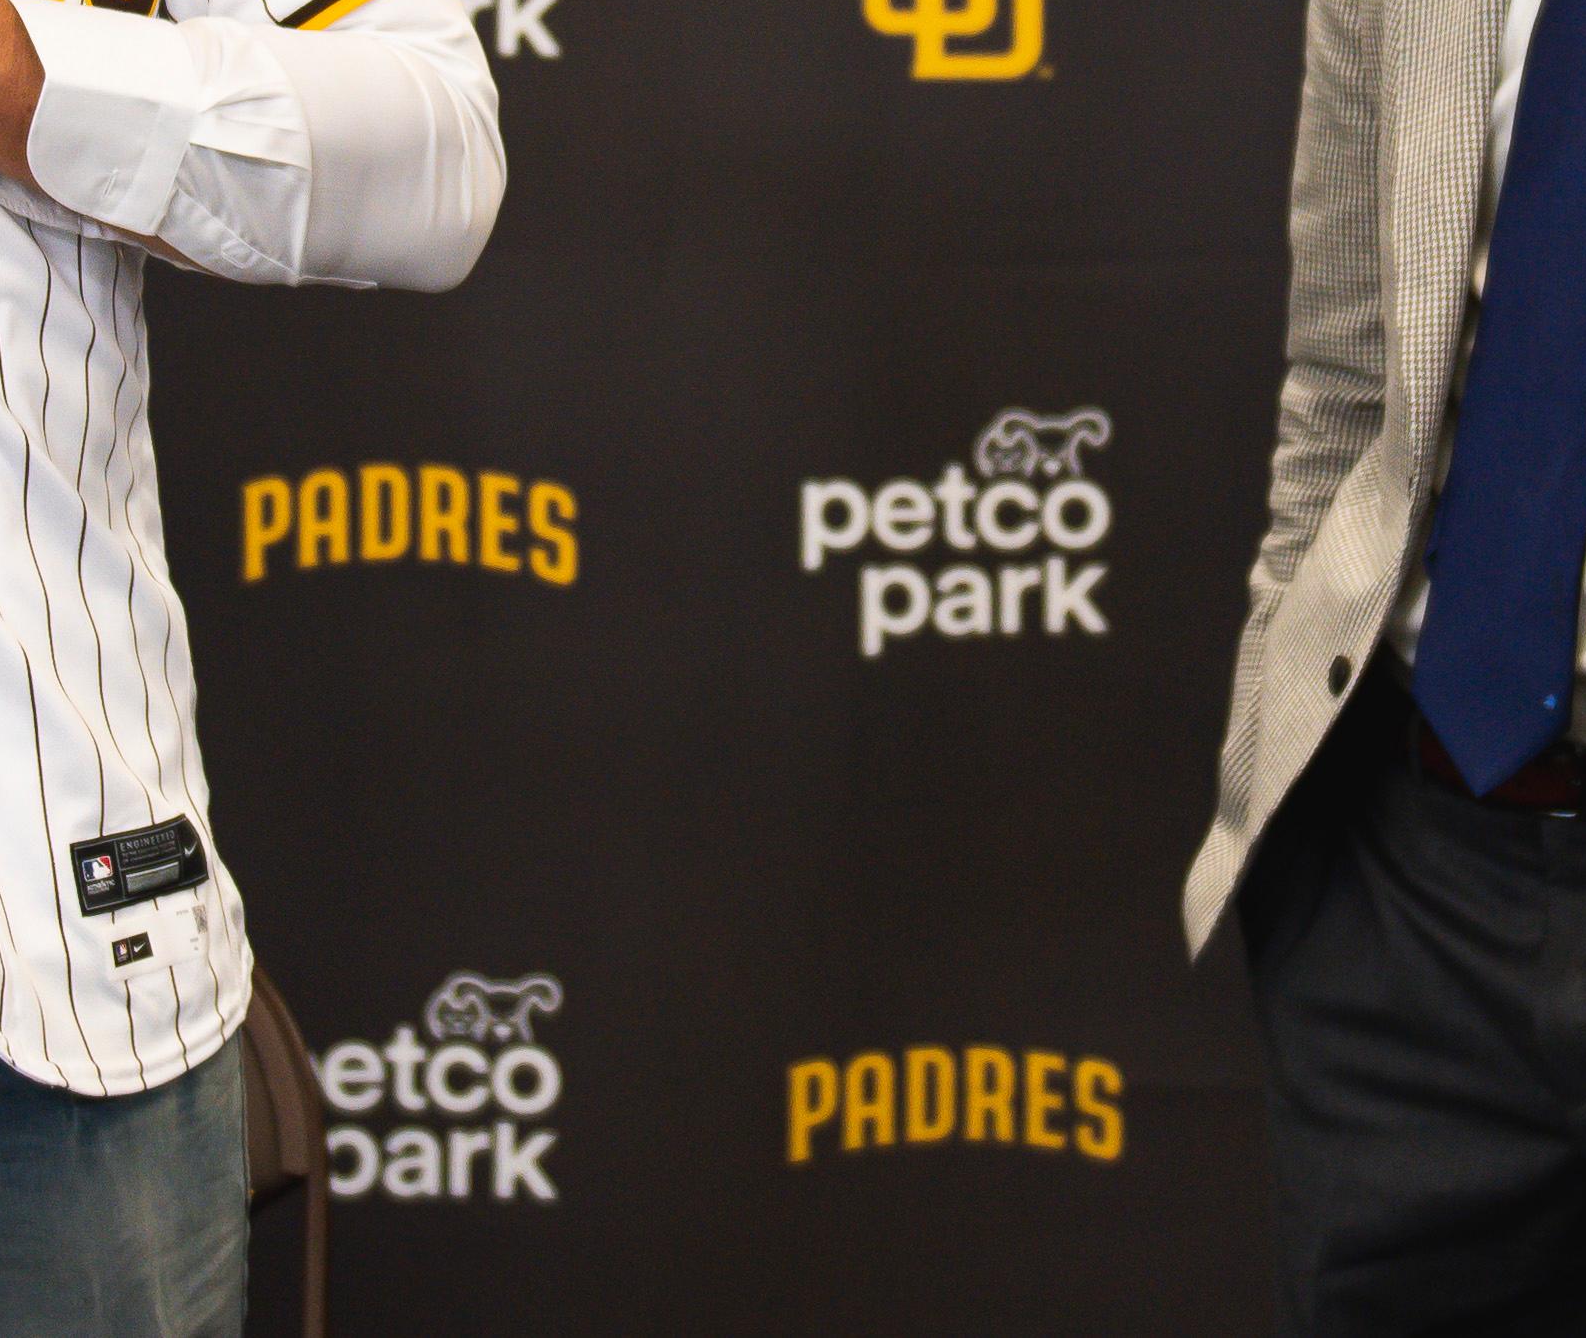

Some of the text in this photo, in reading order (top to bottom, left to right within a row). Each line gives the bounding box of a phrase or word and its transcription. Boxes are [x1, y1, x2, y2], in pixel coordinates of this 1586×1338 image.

[242, 465, 577, 586] PADRES
[800, 463, 1111, 572] petco
[860, 557, 1111, 657] park
[310, 1024, 562, 1115] etco
[786, 1048, 1123, 1166] PADRES
